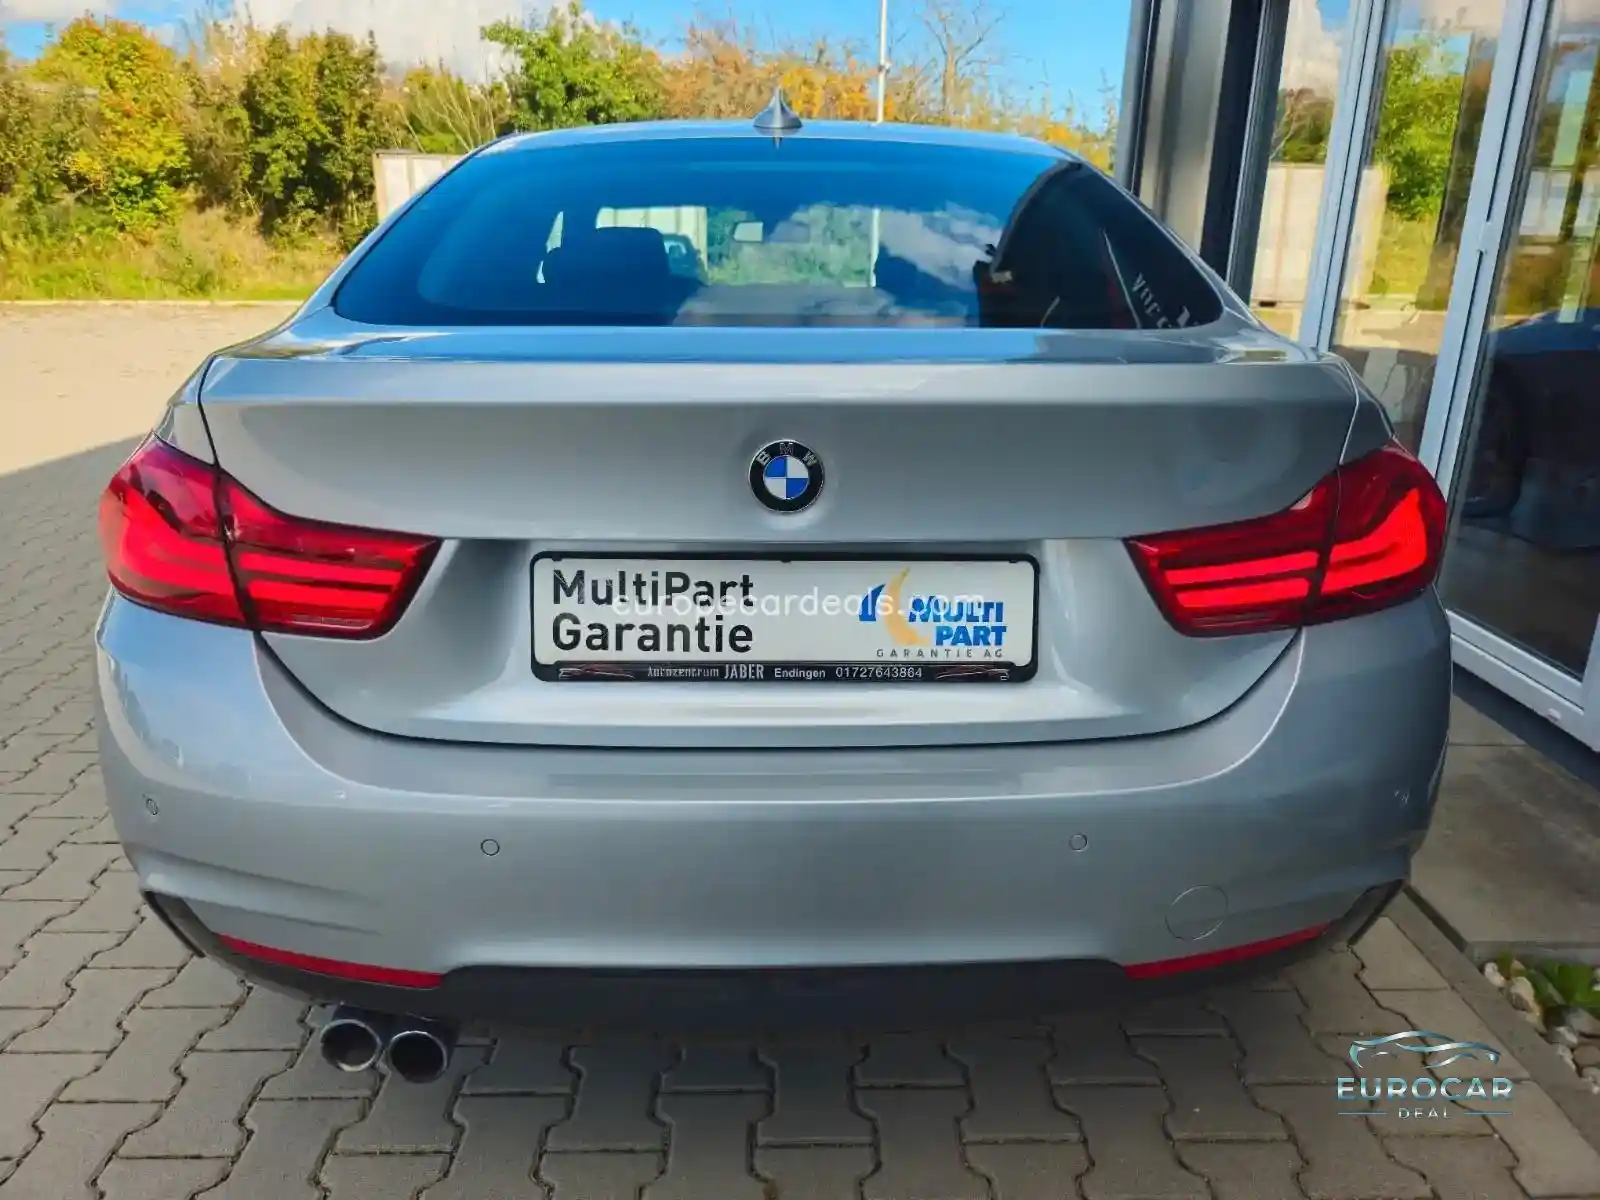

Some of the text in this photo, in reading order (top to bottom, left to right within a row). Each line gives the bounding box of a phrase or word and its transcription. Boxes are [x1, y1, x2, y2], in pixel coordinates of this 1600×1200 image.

[756, 443, 817, 466] BMW
[553, 569, 754, 606] MultiPart
[908, 596, 1004, 622] MULTI
[552, 612, 753, 652] Garantie
[935, 625, 1007, 646] PART
[876, 648, 1003, 658] GARANTIE AG
[724, 664, 765, 679] JABER
[774, 668, 826, 679] Endingen
[835, 667, 922, 678] 01727643864
